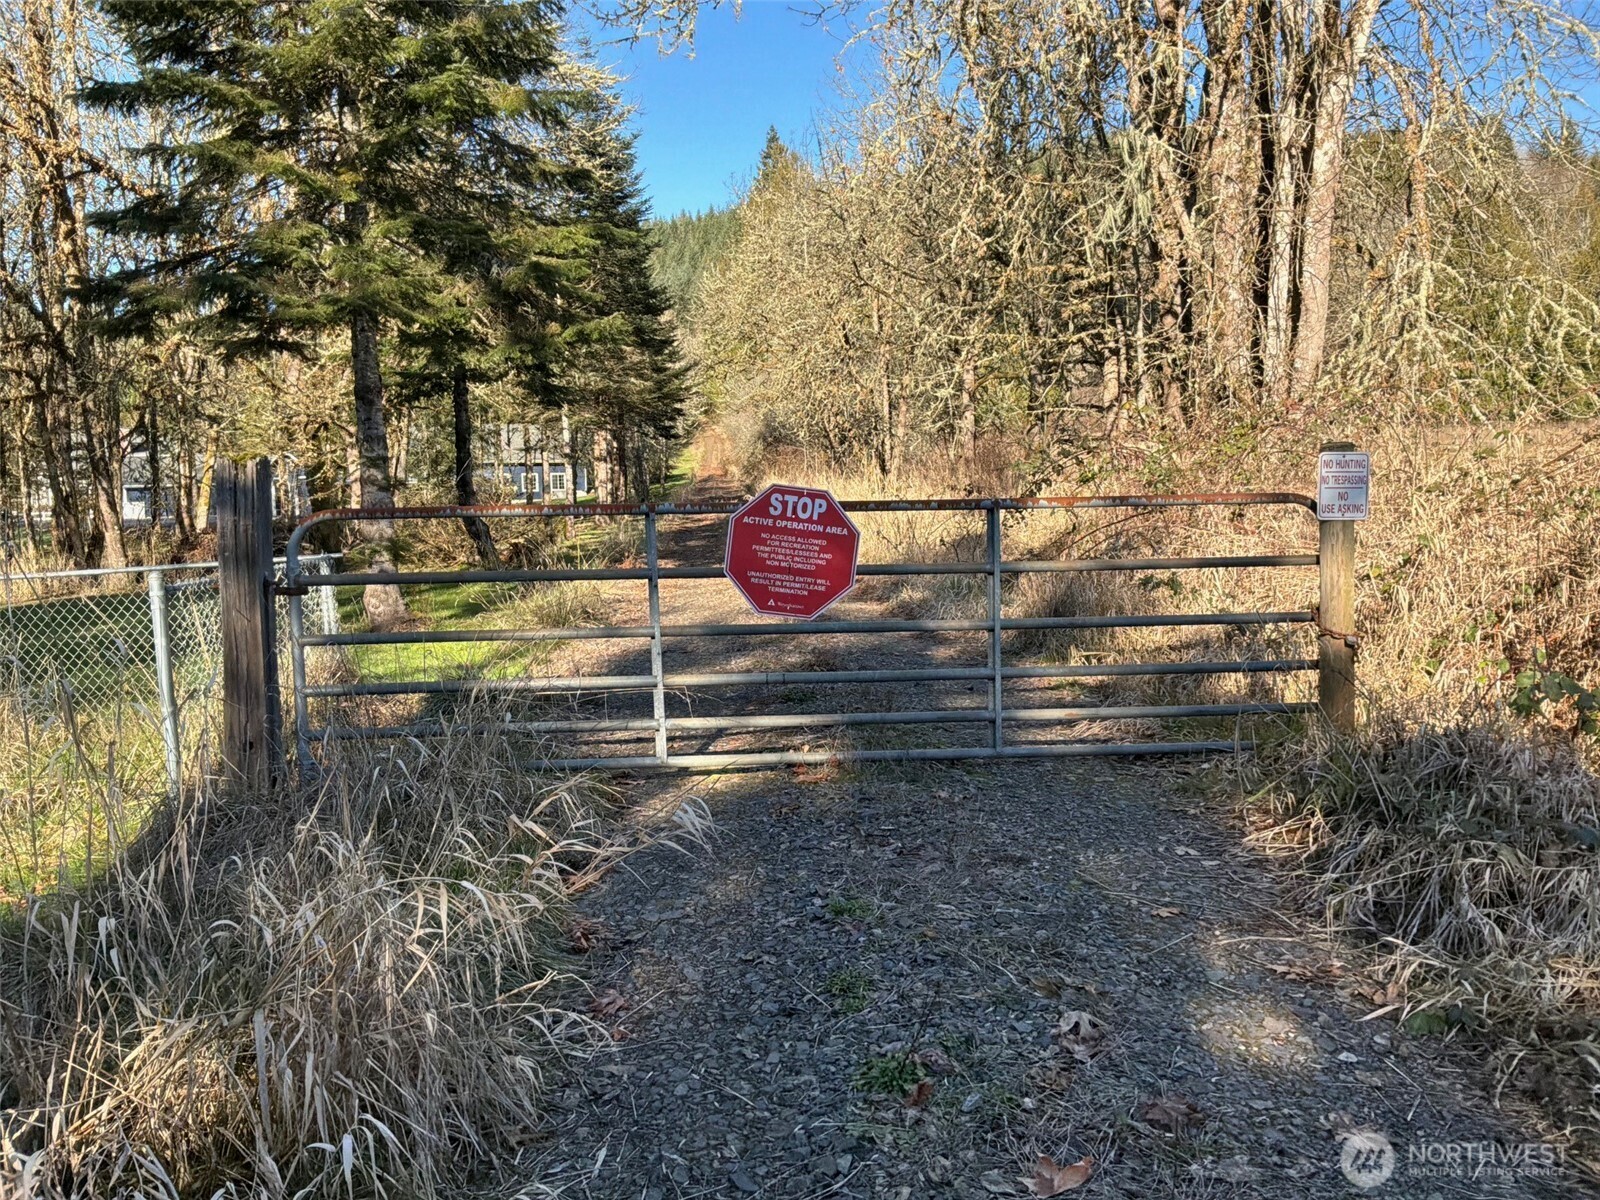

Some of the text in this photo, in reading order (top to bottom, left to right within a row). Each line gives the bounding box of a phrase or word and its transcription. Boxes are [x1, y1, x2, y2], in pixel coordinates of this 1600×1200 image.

[1323, 460, 1366, 469] NO HUNTING
[1321, 474, 1367, 485] NO TRESPASSING
[1338, 492, 1348, 501] NO
[769, 493, 828, 520] STOP
[1322, 504, 1364, 514] USE ASKING
[743, 516, 848, 536] ACTIVE OPERATION AREA
[781, 542, 820, 551] RECREATION
[797, 537, 827, 546] ALLOWED
[752, 545, 818, 558] PERMITTEES/LESSEES
[781, 561, 816, 570] MOTORIZED
[794, 557, 826, 565] INCLUDING
[747, 571, 794, 581] UNAUTHORIZED
[768, 586, 808, 596] TERMINATION
[782, 581, 826, 591] PERMIT/LEASE
